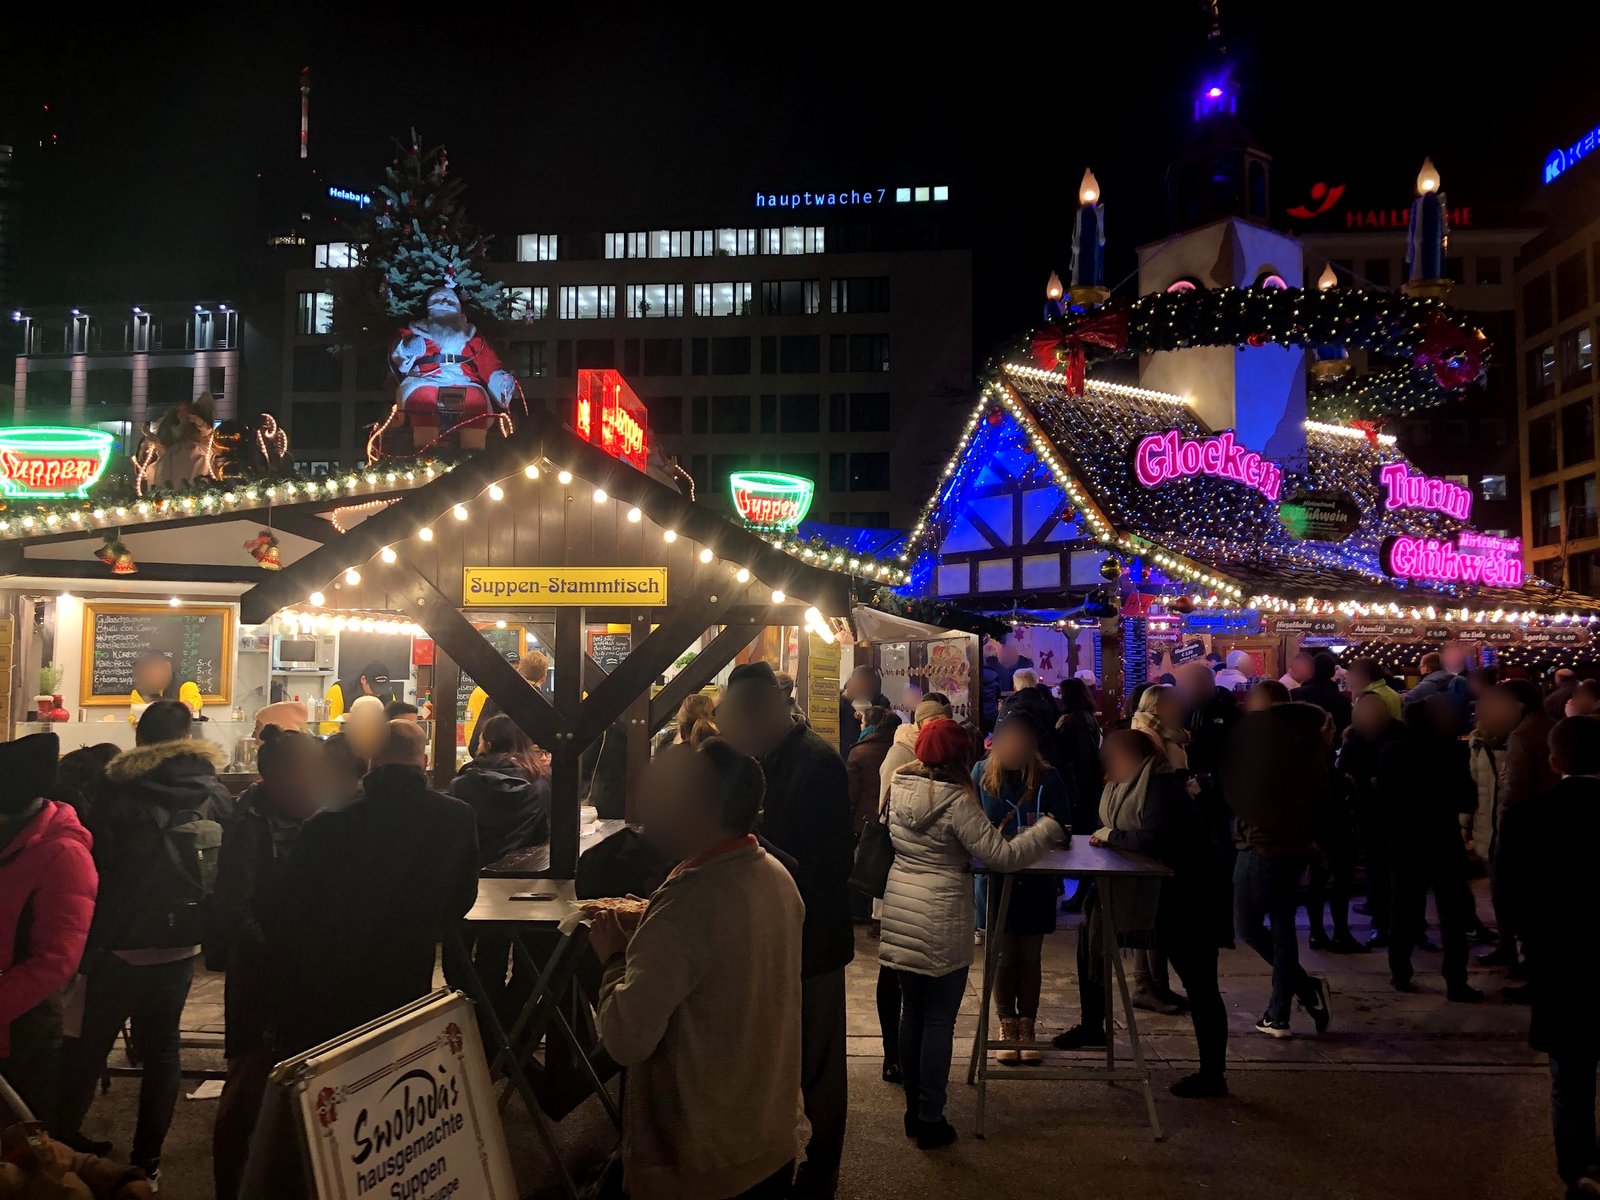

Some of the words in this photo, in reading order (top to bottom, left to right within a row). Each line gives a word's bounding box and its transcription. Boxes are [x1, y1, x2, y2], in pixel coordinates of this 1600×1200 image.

[329, 187, 361, 202] Helaba
[1346, 206, 1473, 228] HALLEHE
[2, 451, 93, 486] Suppen
[1137, 430, 1281, 500] Glocken
[737, 489, 799, 521] Suppen
[1381, 463, 1471, 520] Turm
[1390, 538, 1522, 585] Glühwein
[470, 577, 660, 597] Suppen-Stammtisch
[1523, 632, 1550, 643] ägertee
[356, 1113, 464, 1196] hausgemachte
[390, 1156, 447, 1200] Suppen
